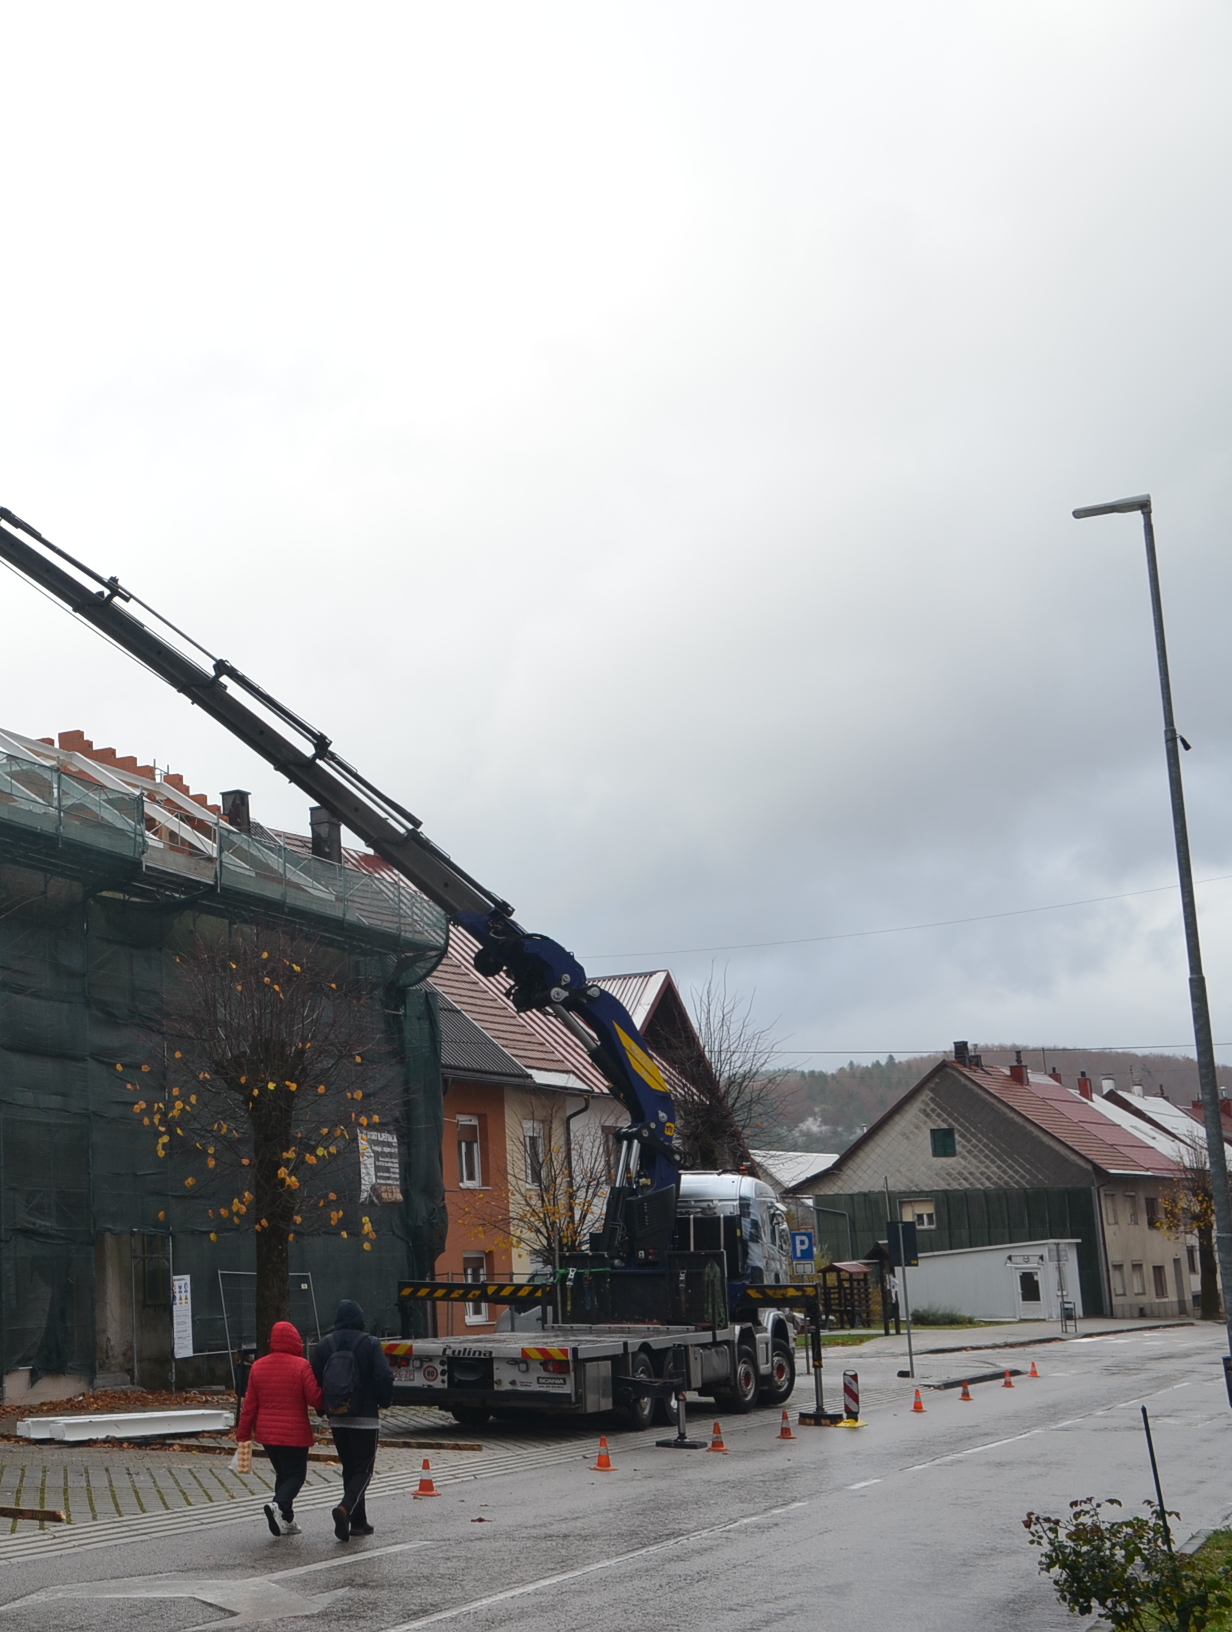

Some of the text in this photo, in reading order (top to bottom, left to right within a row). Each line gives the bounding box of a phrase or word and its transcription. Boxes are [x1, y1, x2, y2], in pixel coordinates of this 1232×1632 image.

[795, 1235, 810, 1258] P
[442, 1344, 494, 1357] Čulina
[426, 1370, 436, 1378] 80
